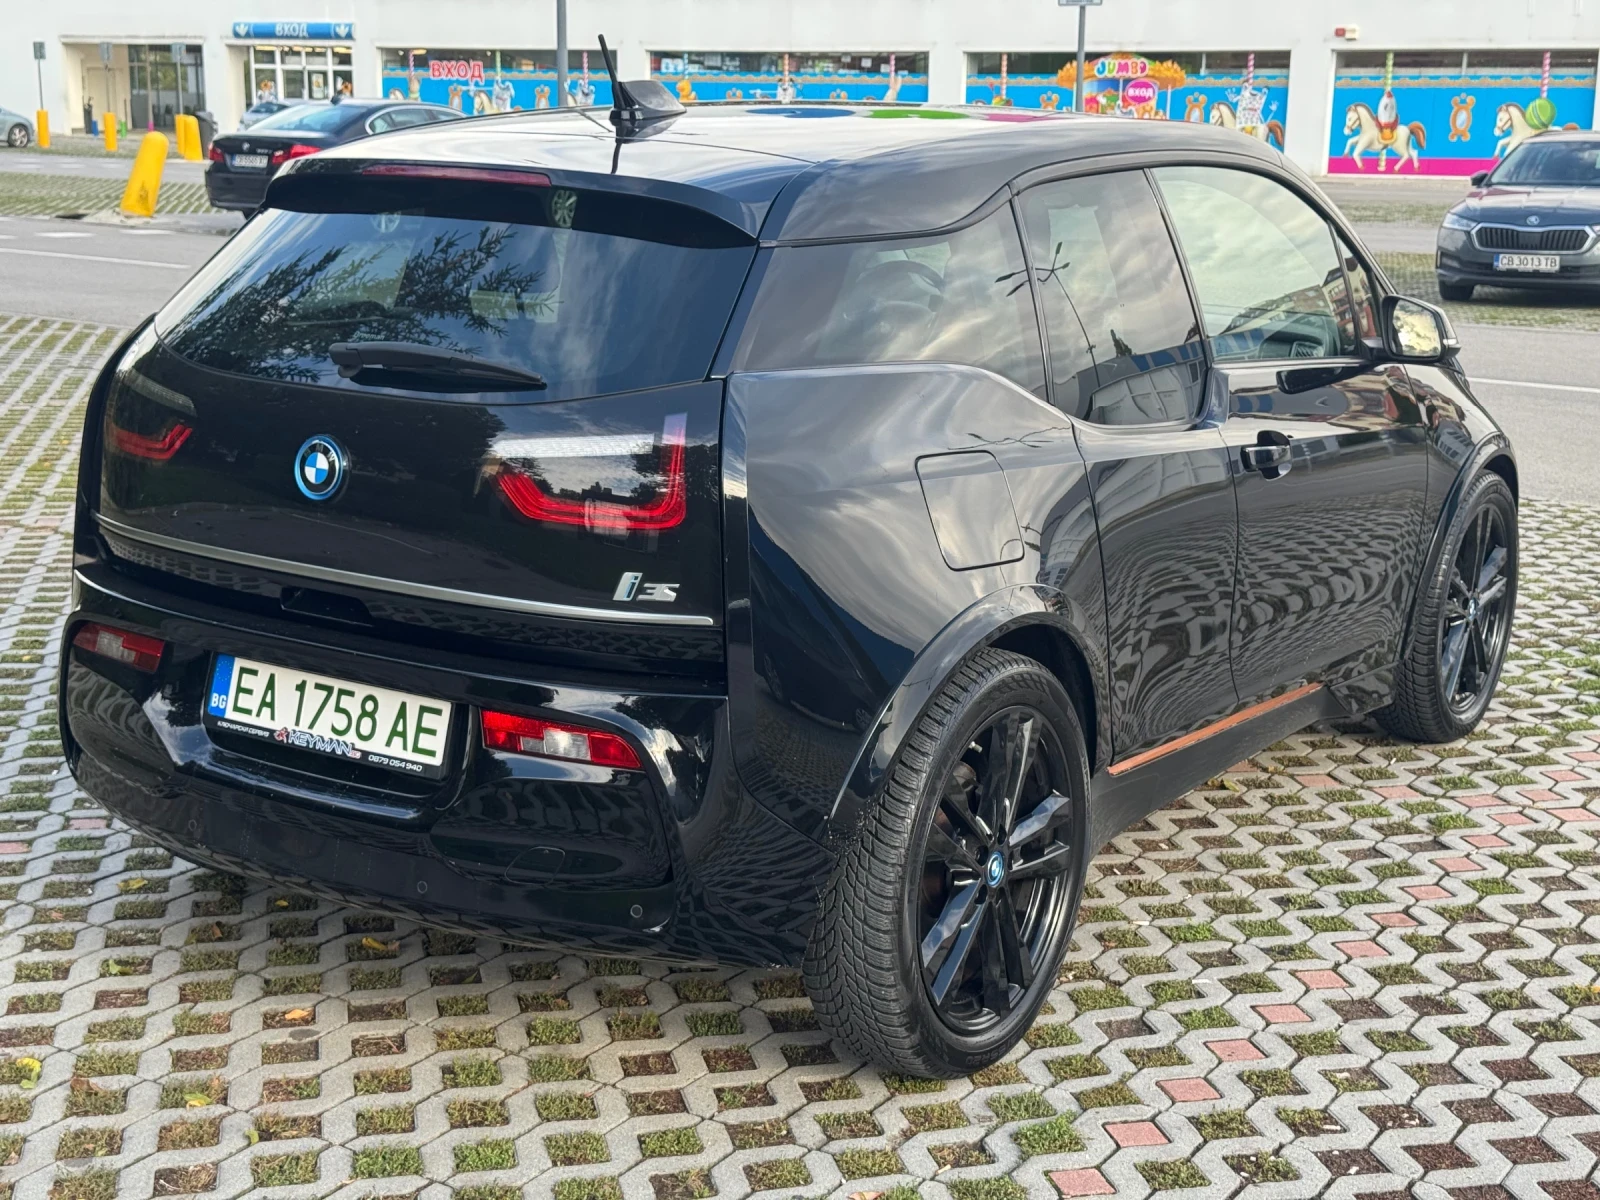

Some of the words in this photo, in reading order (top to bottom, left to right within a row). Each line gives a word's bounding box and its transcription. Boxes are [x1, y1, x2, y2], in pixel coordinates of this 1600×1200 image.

[275, 22, 308, 38] ВХОД
[429, 60, 485, 83] ВХОД
[1096, 59, 1148, 77] JUMBO
[1127, 87, 1154, 99] ВХОД
[1500, 255, 1514, 266] CB
[1515, 256, 1541, 267] 3013
[1545, 257, 1557, 268] TB
[304, 443, 336, 462] BMW
[211, 693, 226, 709] BG
[232, 666, 276, 722] EA
[294, 680, 379, 742] 1758
[385, 701, 443, 758] AE
[368, 754, 388, 765] 0879
[389, 759, 406, 769] 054
[405, 762, 423, 772] 940
